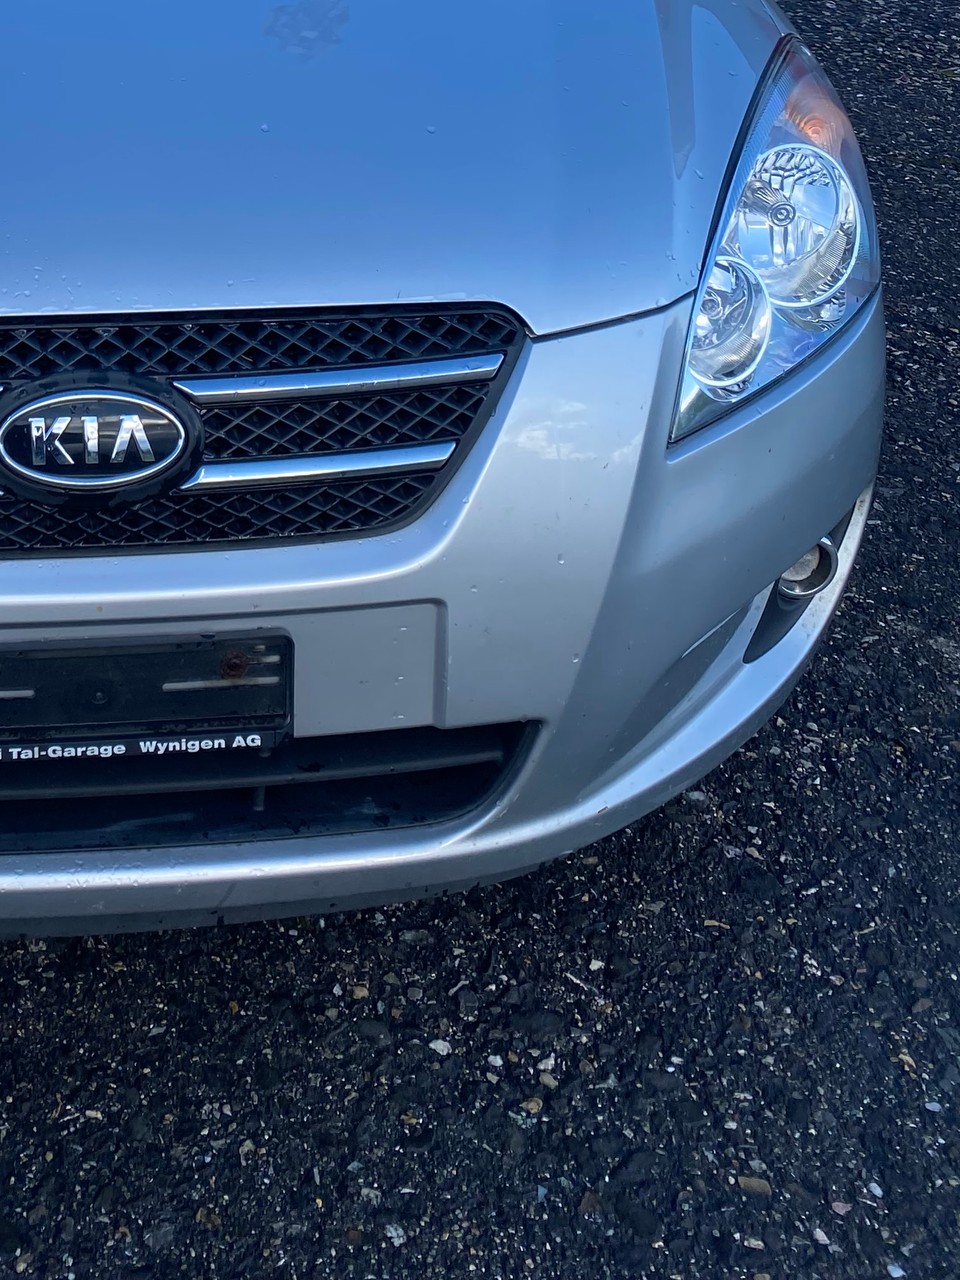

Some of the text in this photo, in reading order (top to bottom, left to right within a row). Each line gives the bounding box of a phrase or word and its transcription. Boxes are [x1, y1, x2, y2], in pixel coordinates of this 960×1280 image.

[28, 414, 156, 466] KIA
[8, 744, 127, 760] Tal-Garage
[139, 738, 226, 755] Wynigen
[232, 734, 262, 748] AG
